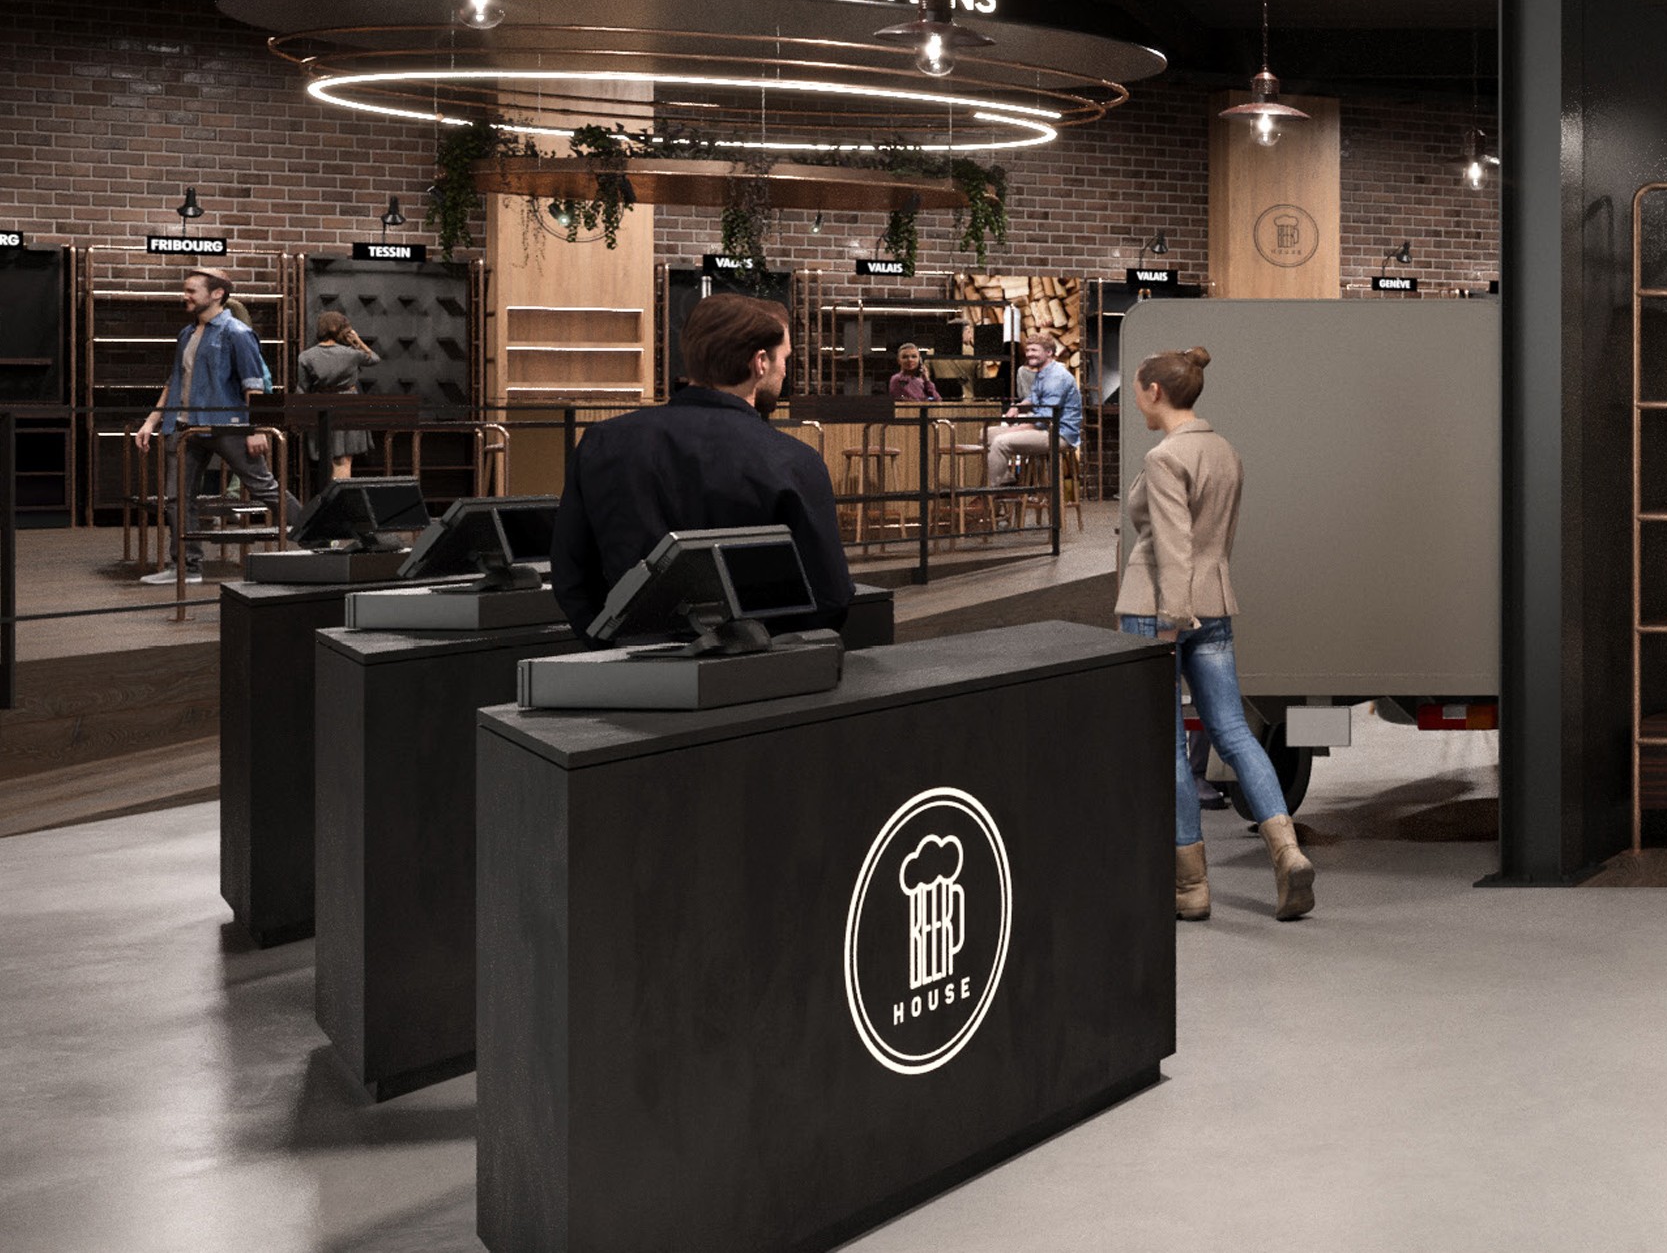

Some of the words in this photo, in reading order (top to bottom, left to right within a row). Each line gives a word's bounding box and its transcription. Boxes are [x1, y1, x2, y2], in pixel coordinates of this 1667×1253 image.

[150, 238, 224, 253] FRIBOURG
[368, 246, 411, 258] TESSIN
[715, 257, 754, 269] VALS
[867, 262, 904, 274] VALAIS
[1136, 271, 1168, 282] VALAIS
[1378, 277, 1411, 289] GENÈVE
[893, 976, 971, 1026] HOUSE
